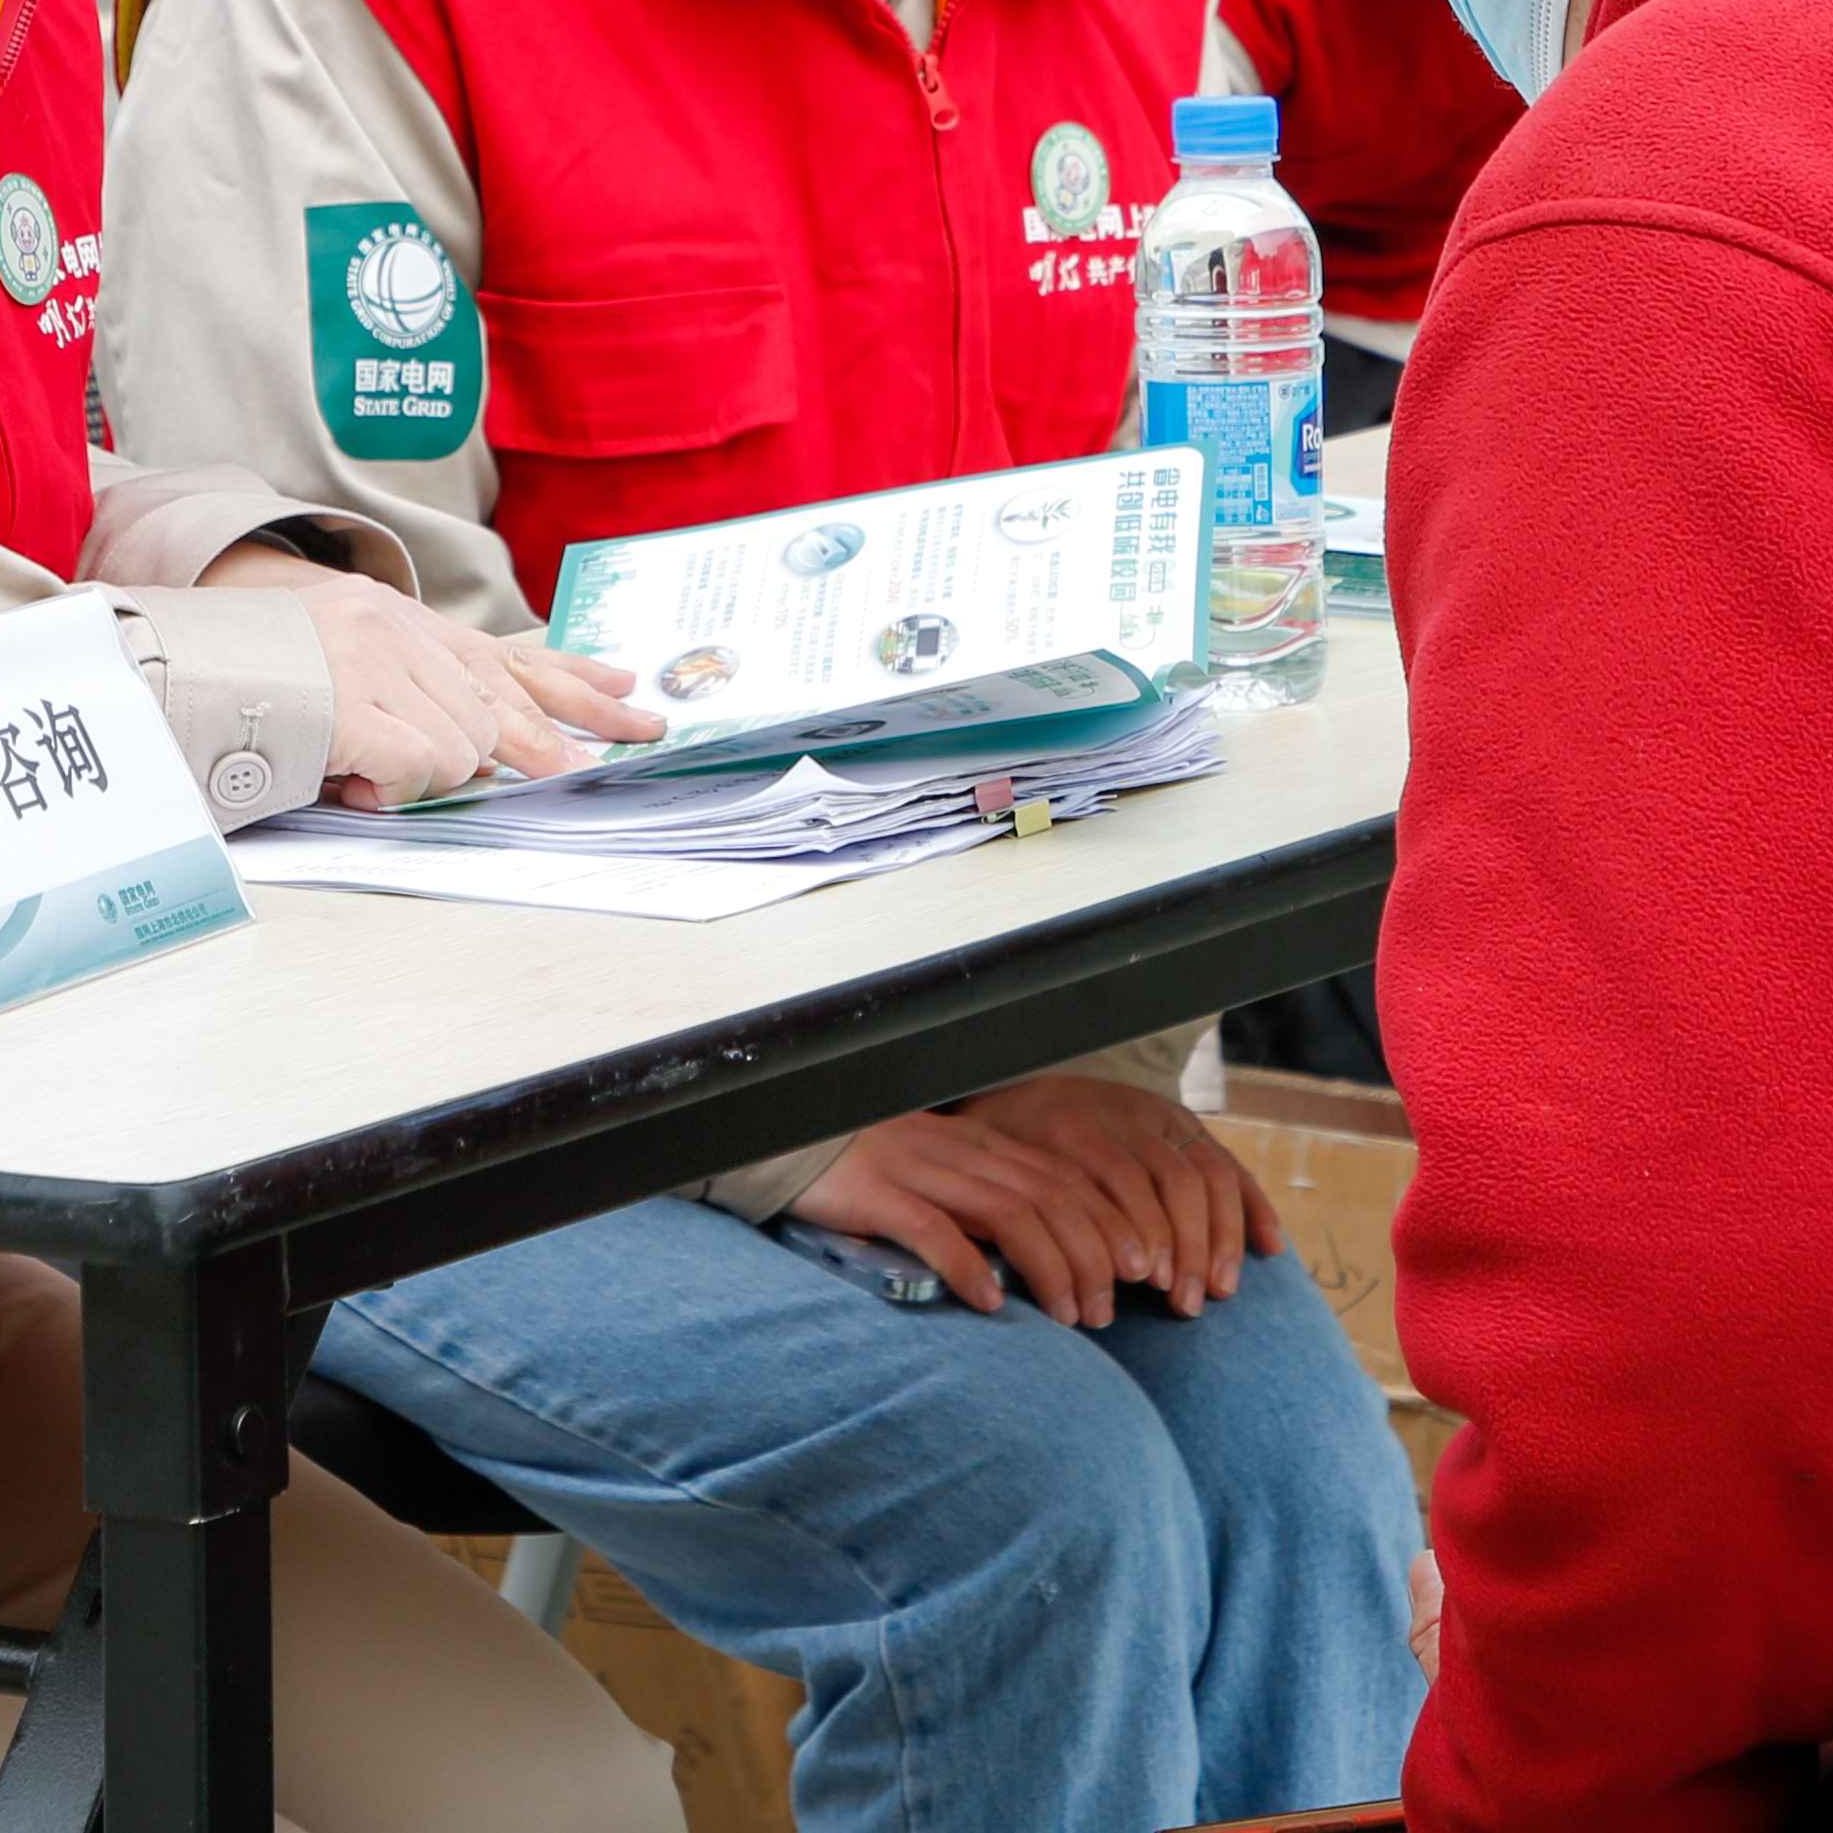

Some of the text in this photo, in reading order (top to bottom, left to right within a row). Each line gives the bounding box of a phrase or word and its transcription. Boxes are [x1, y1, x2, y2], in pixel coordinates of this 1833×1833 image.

[355, 356, 455, 396] 国家电网
[1147, 467, 1181, 554] 省电有我
